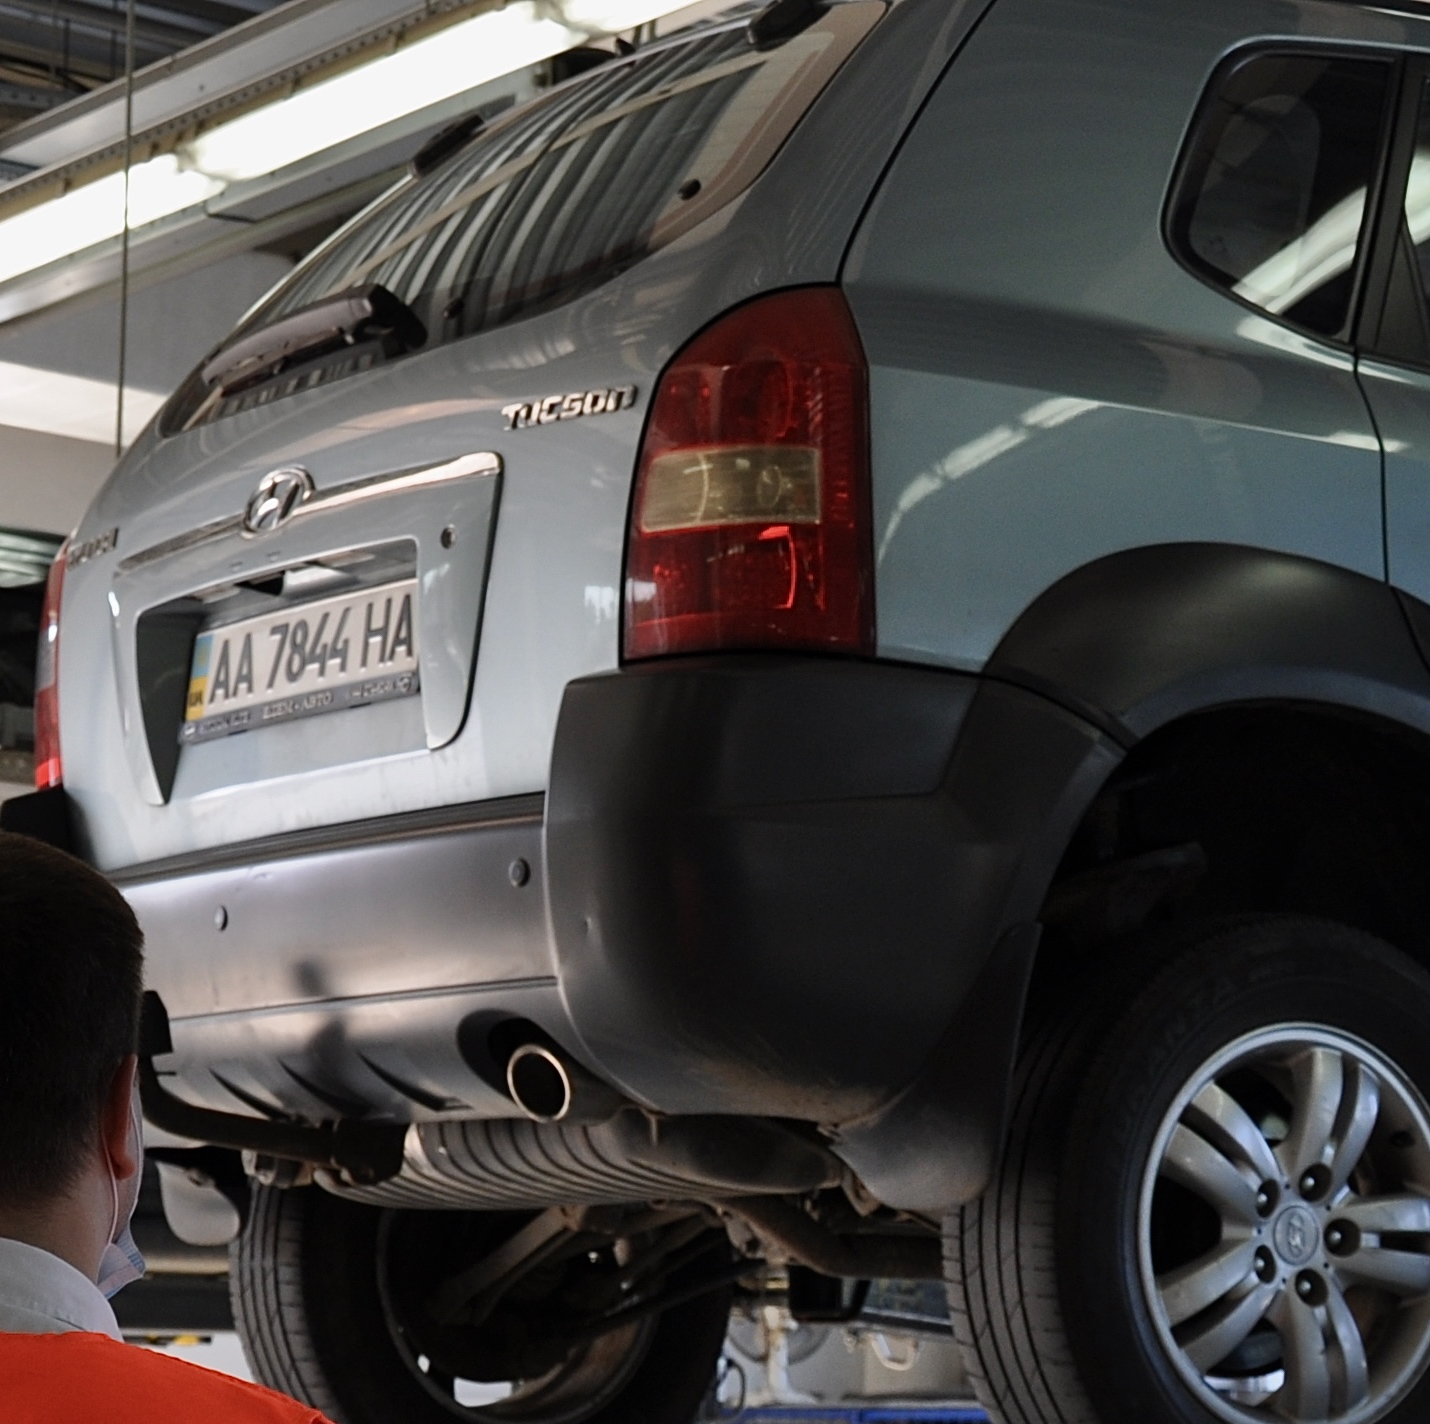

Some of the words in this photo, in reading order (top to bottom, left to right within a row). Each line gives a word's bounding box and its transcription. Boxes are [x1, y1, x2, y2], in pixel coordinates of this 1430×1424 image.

[501, 384, 638, 431] TUCSON
[208, 632, 254, 704] AA
[266, 606, 352, 690] 7844
[359, 593, 413, 671] HA
